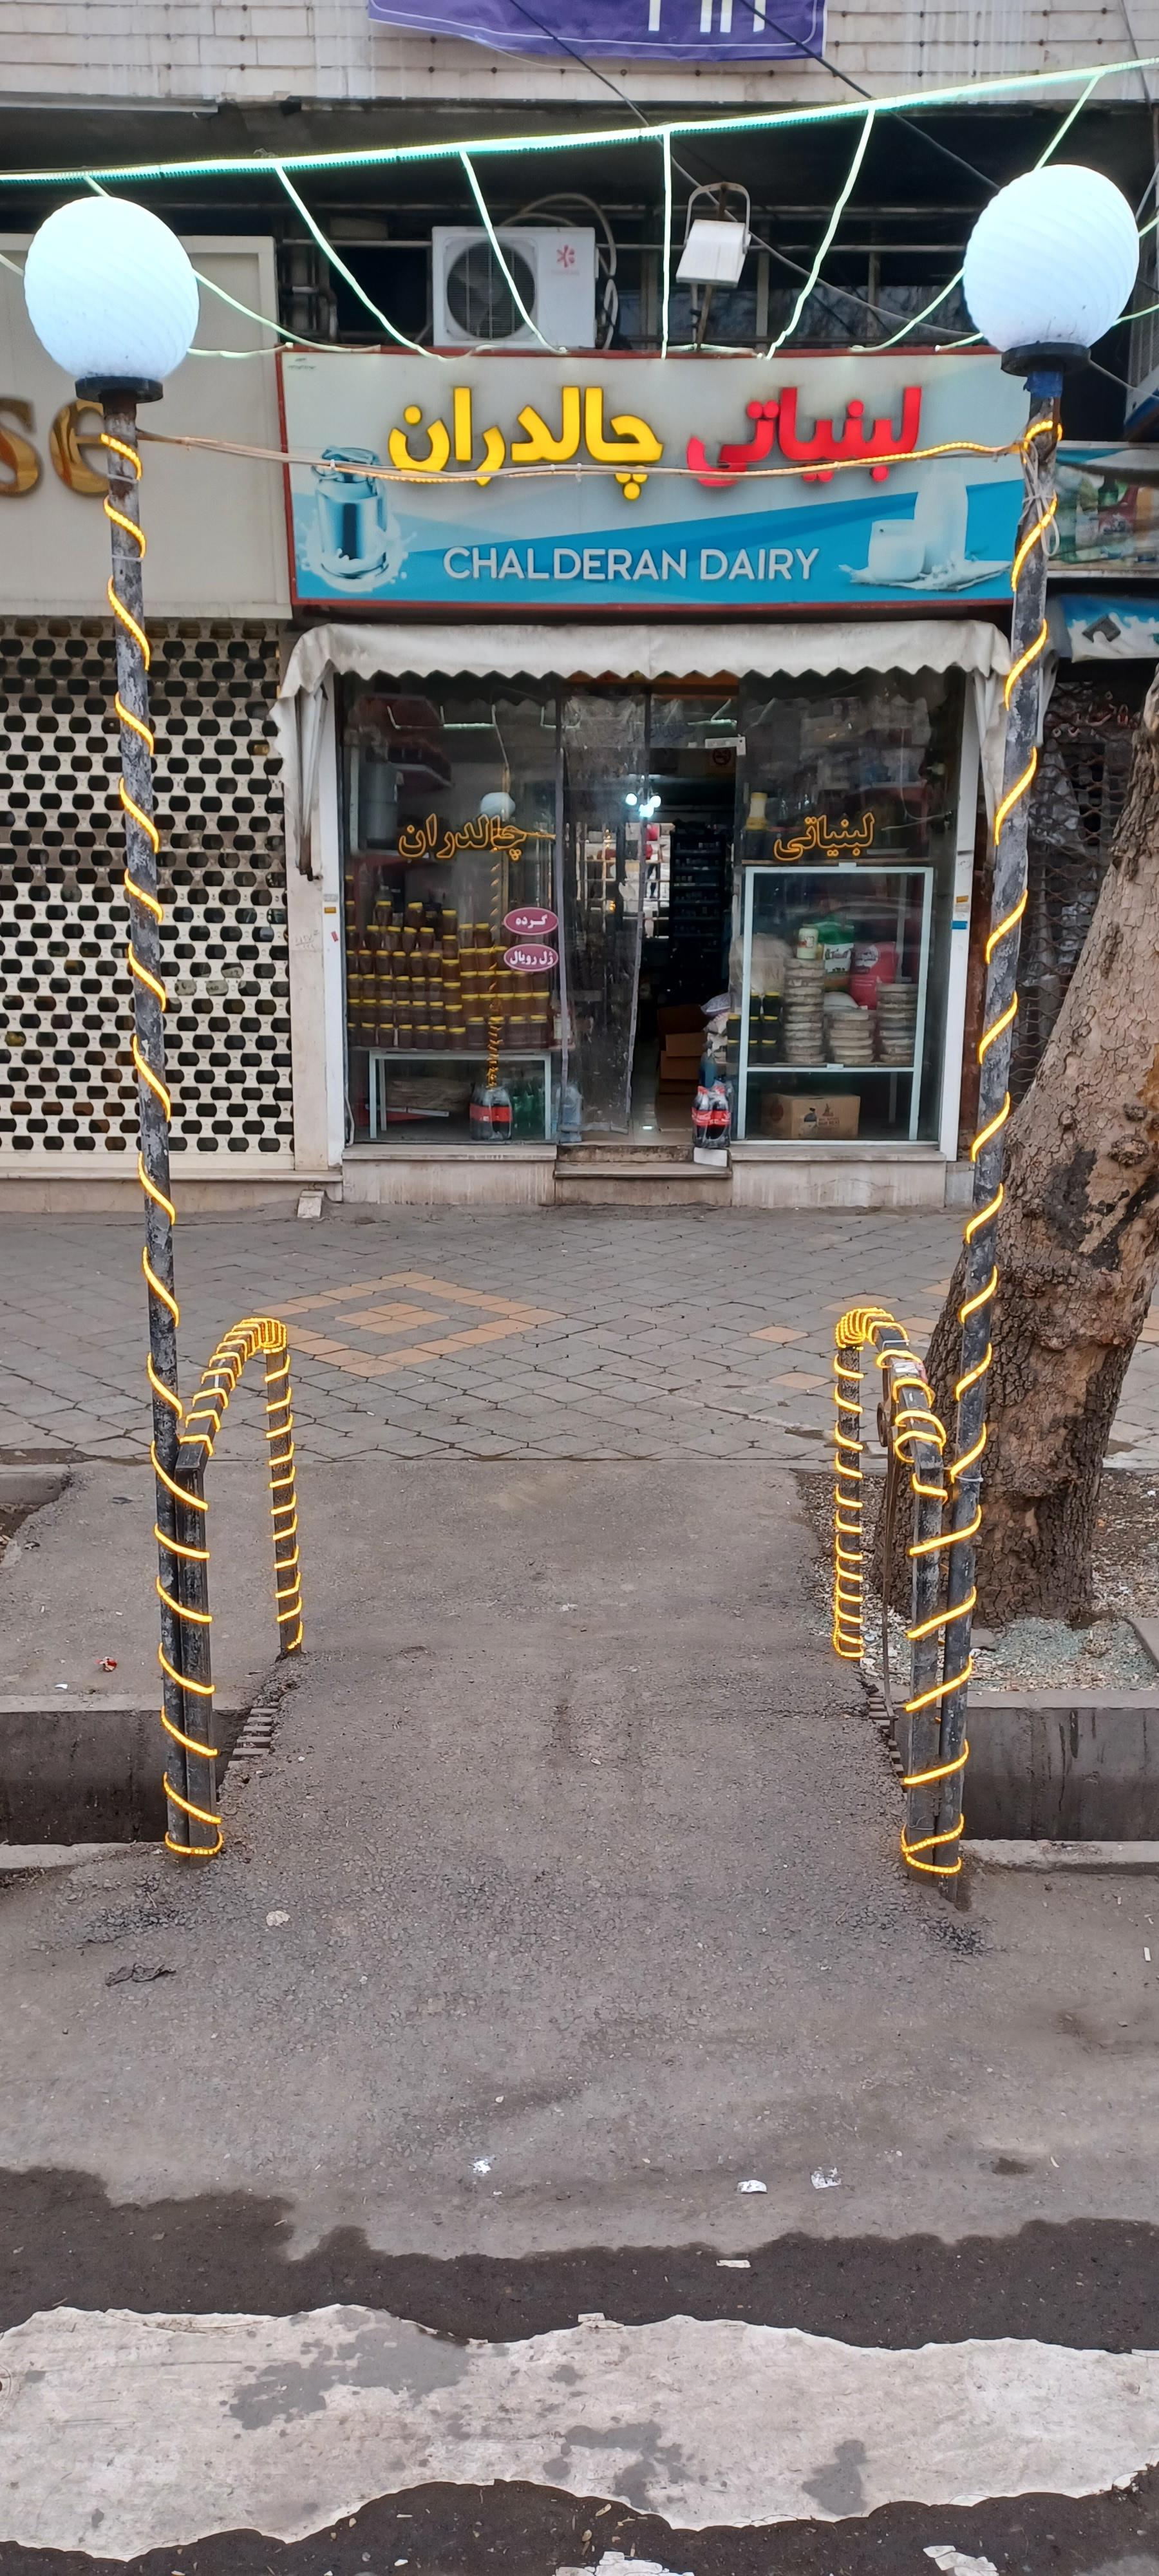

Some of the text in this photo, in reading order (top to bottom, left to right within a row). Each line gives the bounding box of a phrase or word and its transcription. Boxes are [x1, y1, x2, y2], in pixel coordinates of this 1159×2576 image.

[389, 387, 922, 500] لبنیاتی چالدران
[444, 546, 819, 580] CHALDERAN DAIRY
[399, 813, 527, 861] چالدران
[774, 812, 874, 861] لبنیاتی
[509, 950, 554, 965] ژل رویال
